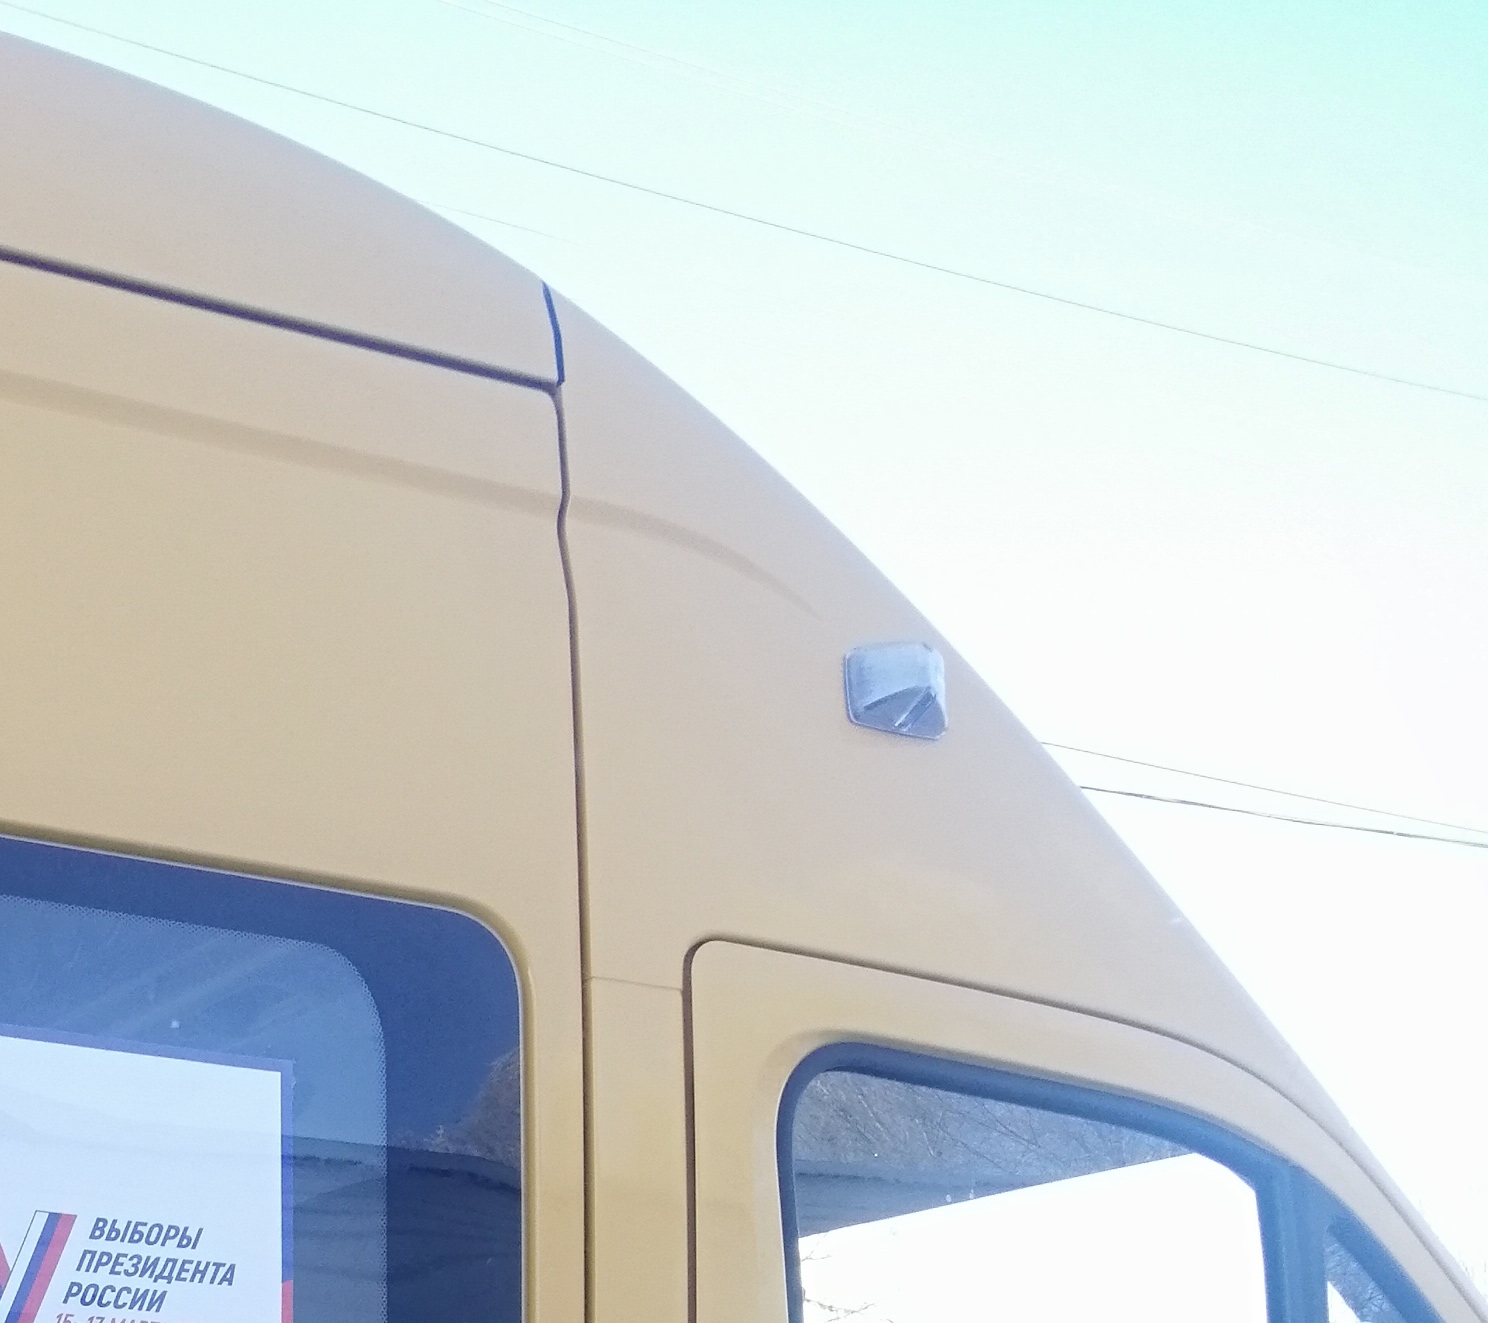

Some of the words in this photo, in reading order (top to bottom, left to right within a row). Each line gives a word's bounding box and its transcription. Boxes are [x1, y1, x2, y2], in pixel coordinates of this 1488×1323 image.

[89, 1217, 204, 1250] ВЫБОРЫ
[76, 1248, 237, 1287] ПРЕЗИДЕНТА
[63, 1282, 168, 1313] РОССИИ
